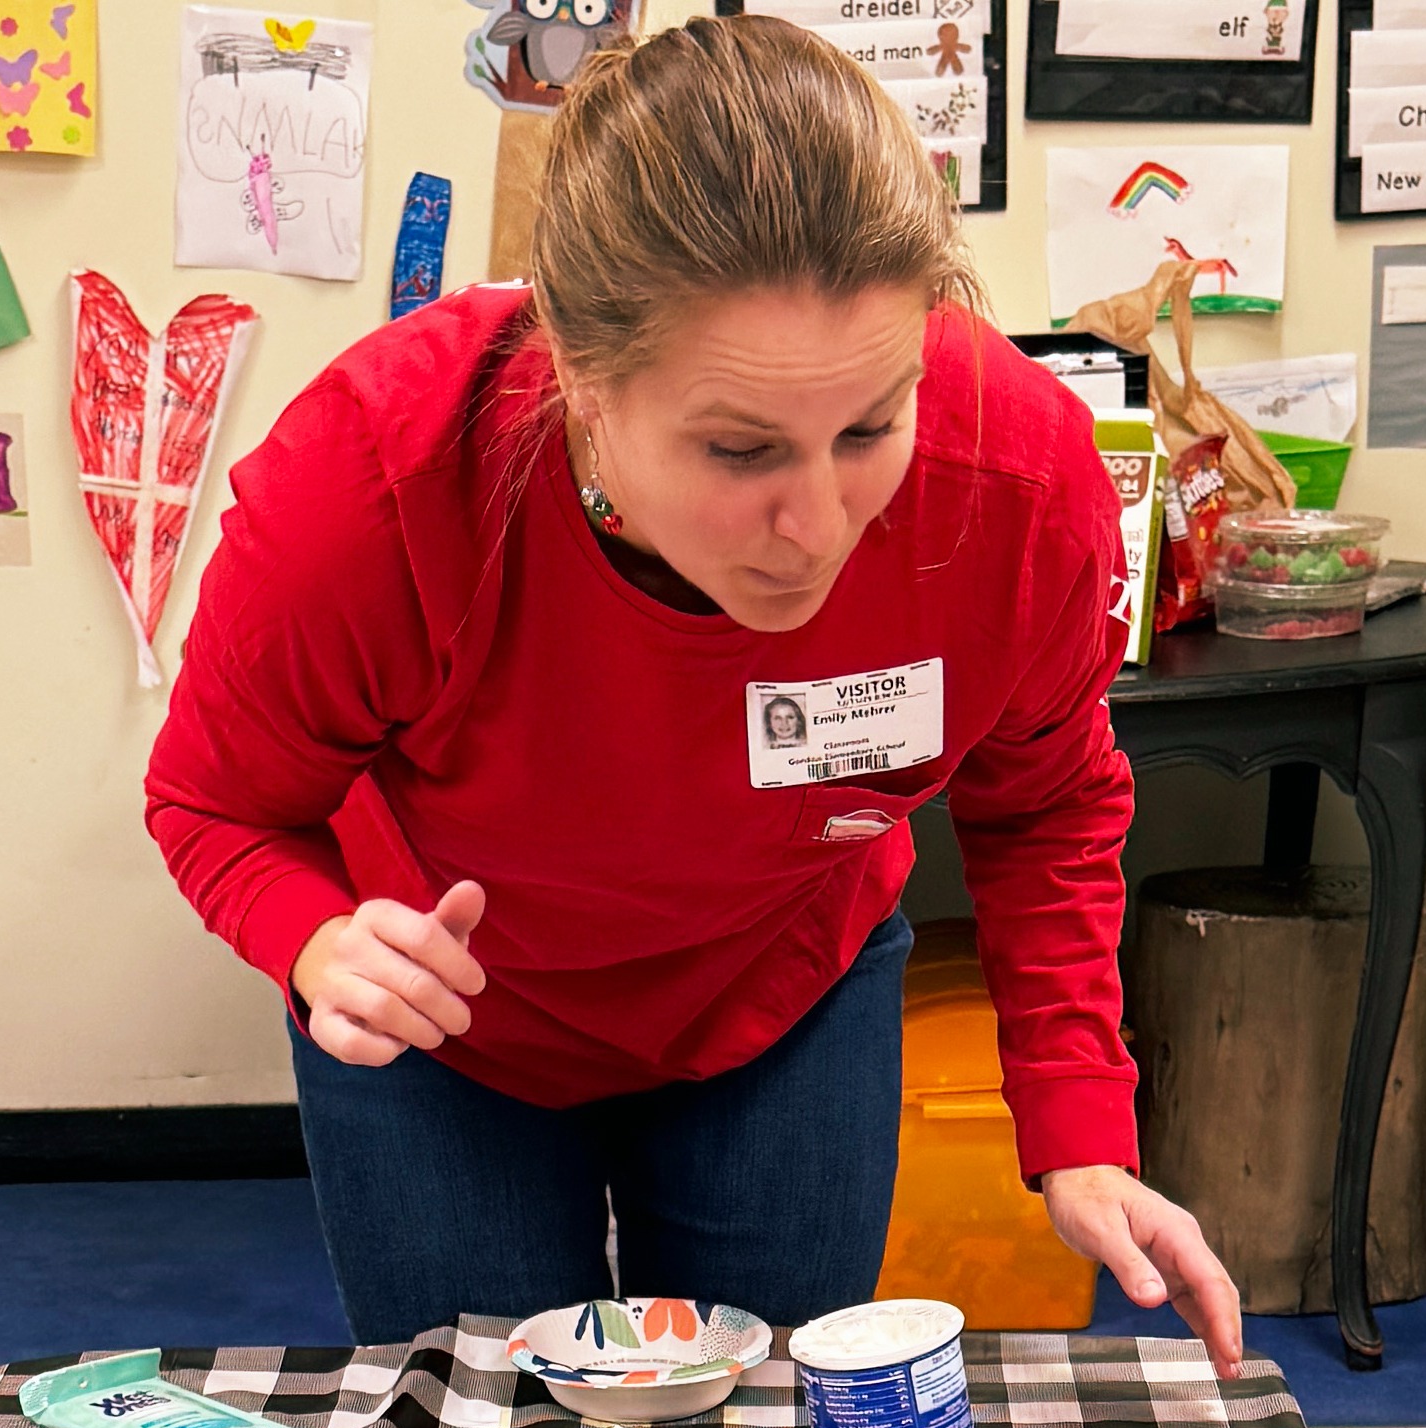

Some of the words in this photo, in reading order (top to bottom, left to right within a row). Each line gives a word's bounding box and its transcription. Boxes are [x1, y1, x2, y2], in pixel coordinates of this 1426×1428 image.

[1219, 16, 1249, 37] elf
[883, 46, 923, 60] man
[1377, 171, 1422, 190] New
[836, 676, 907, 699] VISITOR
[813, 713, 847, 725] Emily
